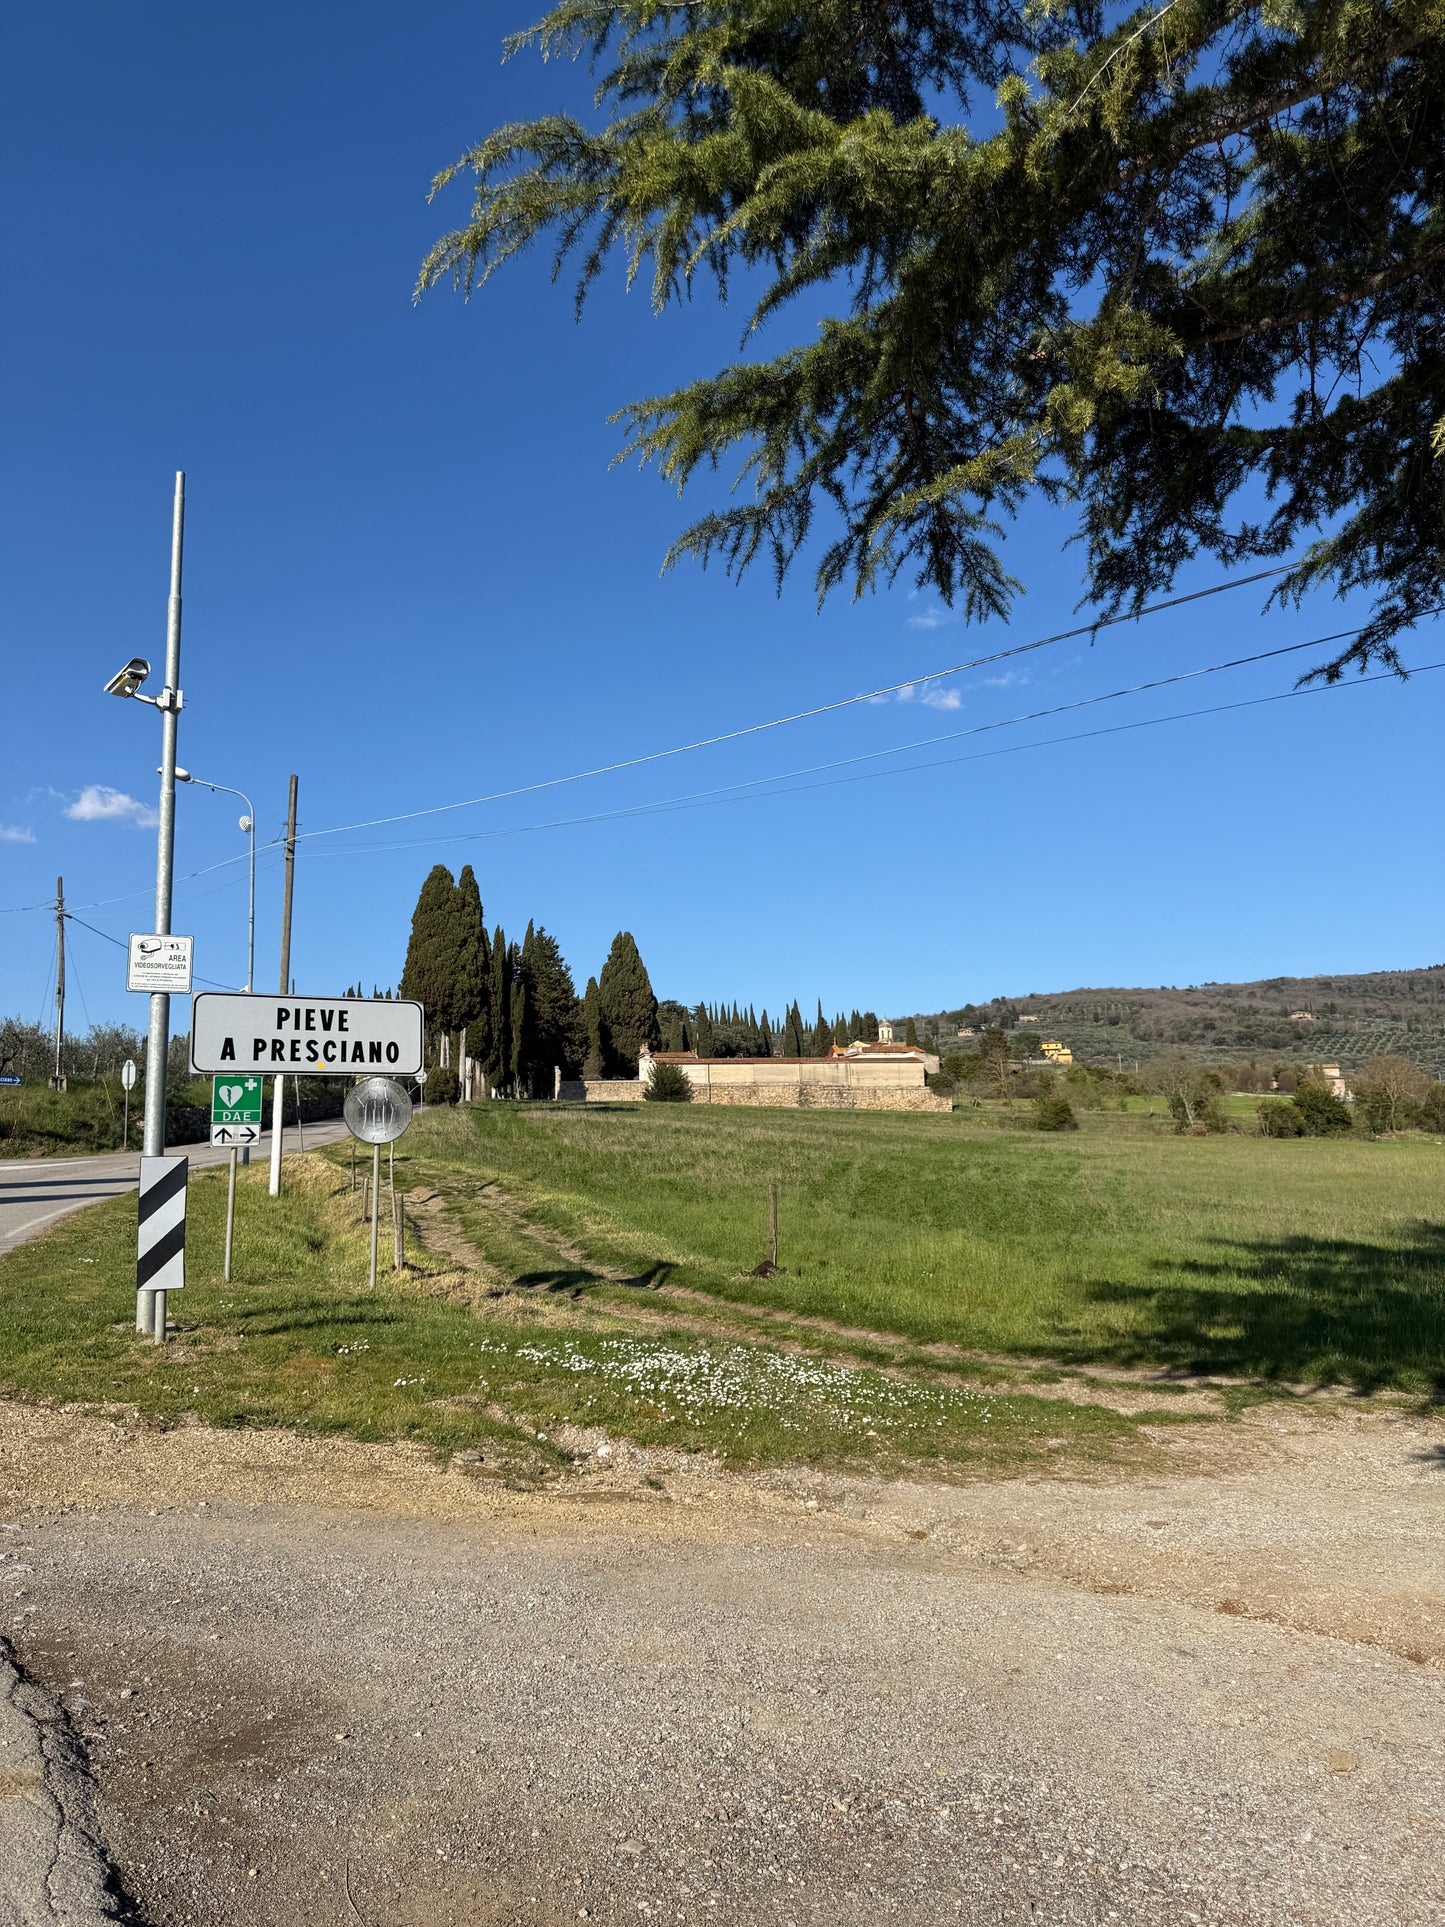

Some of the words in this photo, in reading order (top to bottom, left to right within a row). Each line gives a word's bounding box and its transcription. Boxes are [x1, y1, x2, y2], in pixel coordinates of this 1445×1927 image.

[276, 1007, 349, 1032] PIEVE
[219, 1037, 236, 1061] A
[252, 1038, 400, 1064] PRESCIANO
[222, 1111, 251, 1121] DAE
